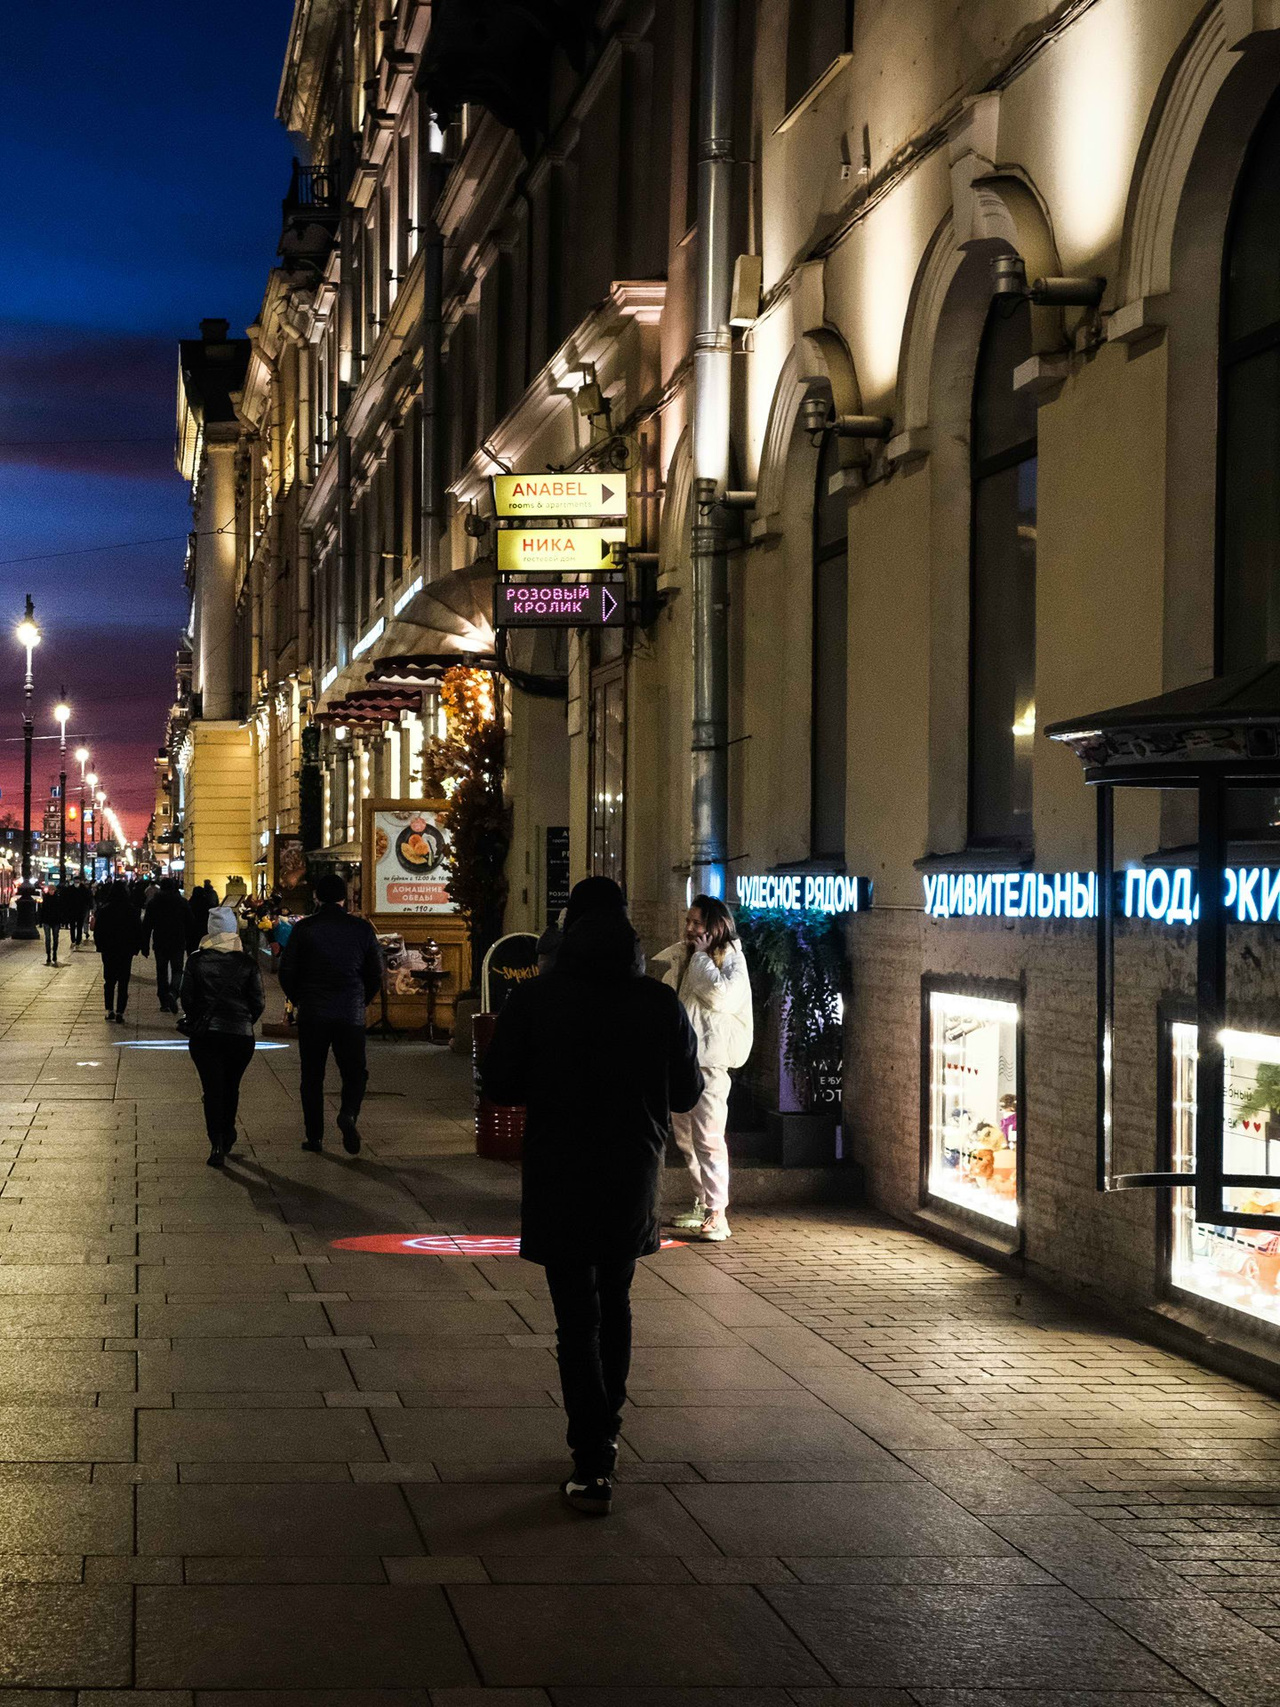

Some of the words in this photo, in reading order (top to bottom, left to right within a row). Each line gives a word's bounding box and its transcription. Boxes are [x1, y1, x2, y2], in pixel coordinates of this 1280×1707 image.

[512, 482, 587, 497] ANABEL
[546, 501, 592, 509] apartments
[522, 538, 576, 552] НИКА
[506, 585, 590, 601] РОЗОВЫЙ
[513, 602, 582, 614] КРОЛИК
[402, 894, 433, 902] ОБЕДЫ
[736, 876, 802, 910] ЧУДЕСНОЕ
[804, 876, 858, 915] РЯДОМ
[923, 872, 1099, 919] УДИВИТЕЛЬНЫ
[1124, 868, 1280, 926] ПОДРКИ
